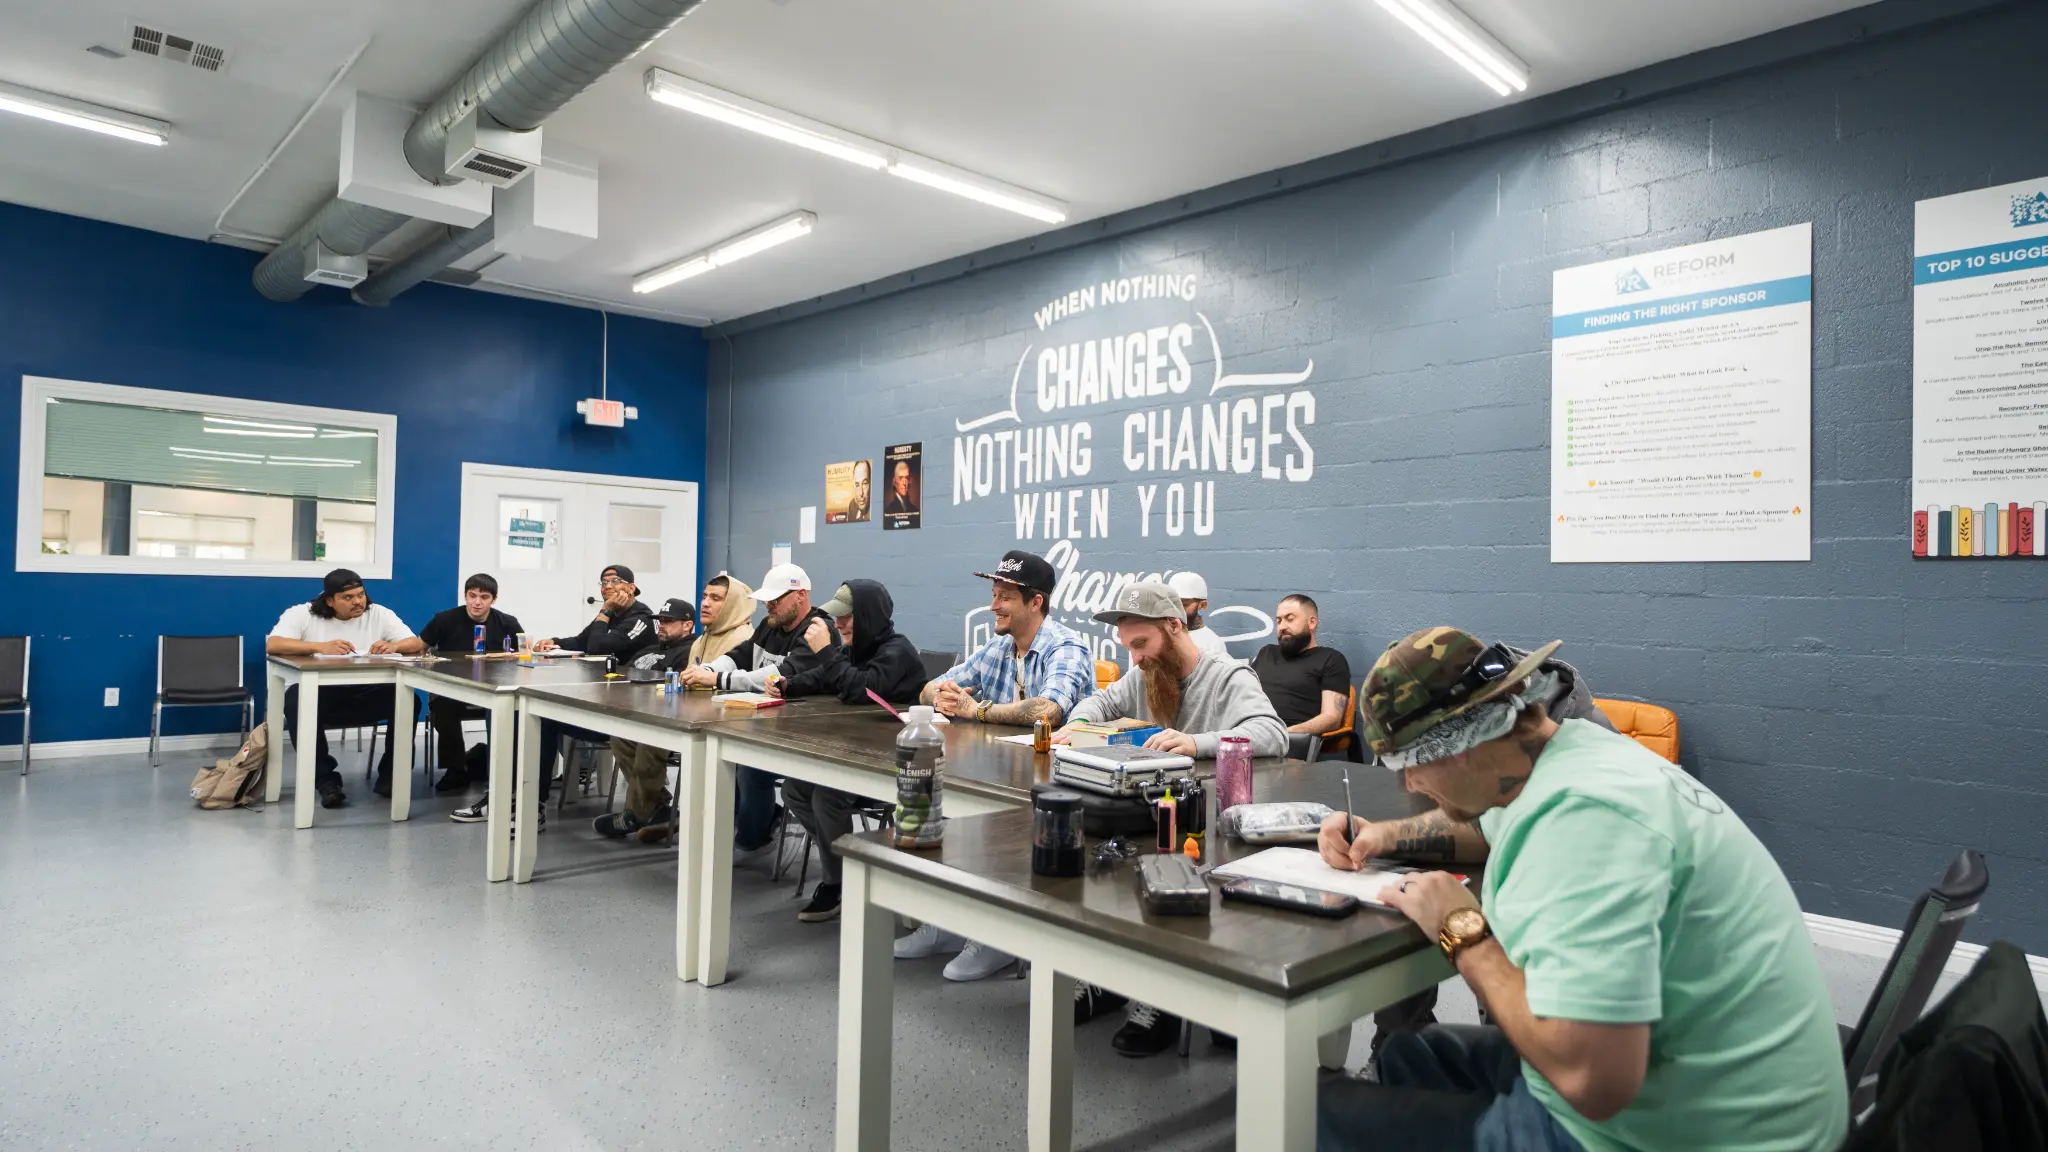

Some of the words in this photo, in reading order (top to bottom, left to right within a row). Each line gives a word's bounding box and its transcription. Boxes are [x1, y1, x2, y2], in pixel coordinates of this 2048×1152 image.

[1653, 252, 1735, 278] REFORM
[1927, 259, 1961, 275] TOP
[1965, 255, 1986, 269] 10
[1993, 280, 2028, 289] Alcoholics
[1034, 285, 1095, 331] WHEN
[1101, 273, 1197, 306] NOTHING
[1584, 312, 1631, 327] FINDING
[1632, 307, 1658, 320] THE
[1660, 301, 1698, 315] RIGHT
[1701, 290, 1767, 309] SPONSOR
[1036, 322, 1193, 414] CHANGES
[1977, 385, 2017, 394] Overcoming
[593, 401, 620, 424] EXIT
[952, 420, 1093, 506] NOTHING
[1123, 390, 1316, 483] CHANGES
[1972, 467, 2004, 476] Breathing
[1013, 486, 1109, 540] WHEN
[1137, 480, 1215, 537] YOU
[1761, 508, 1790, 517] Sponsor
